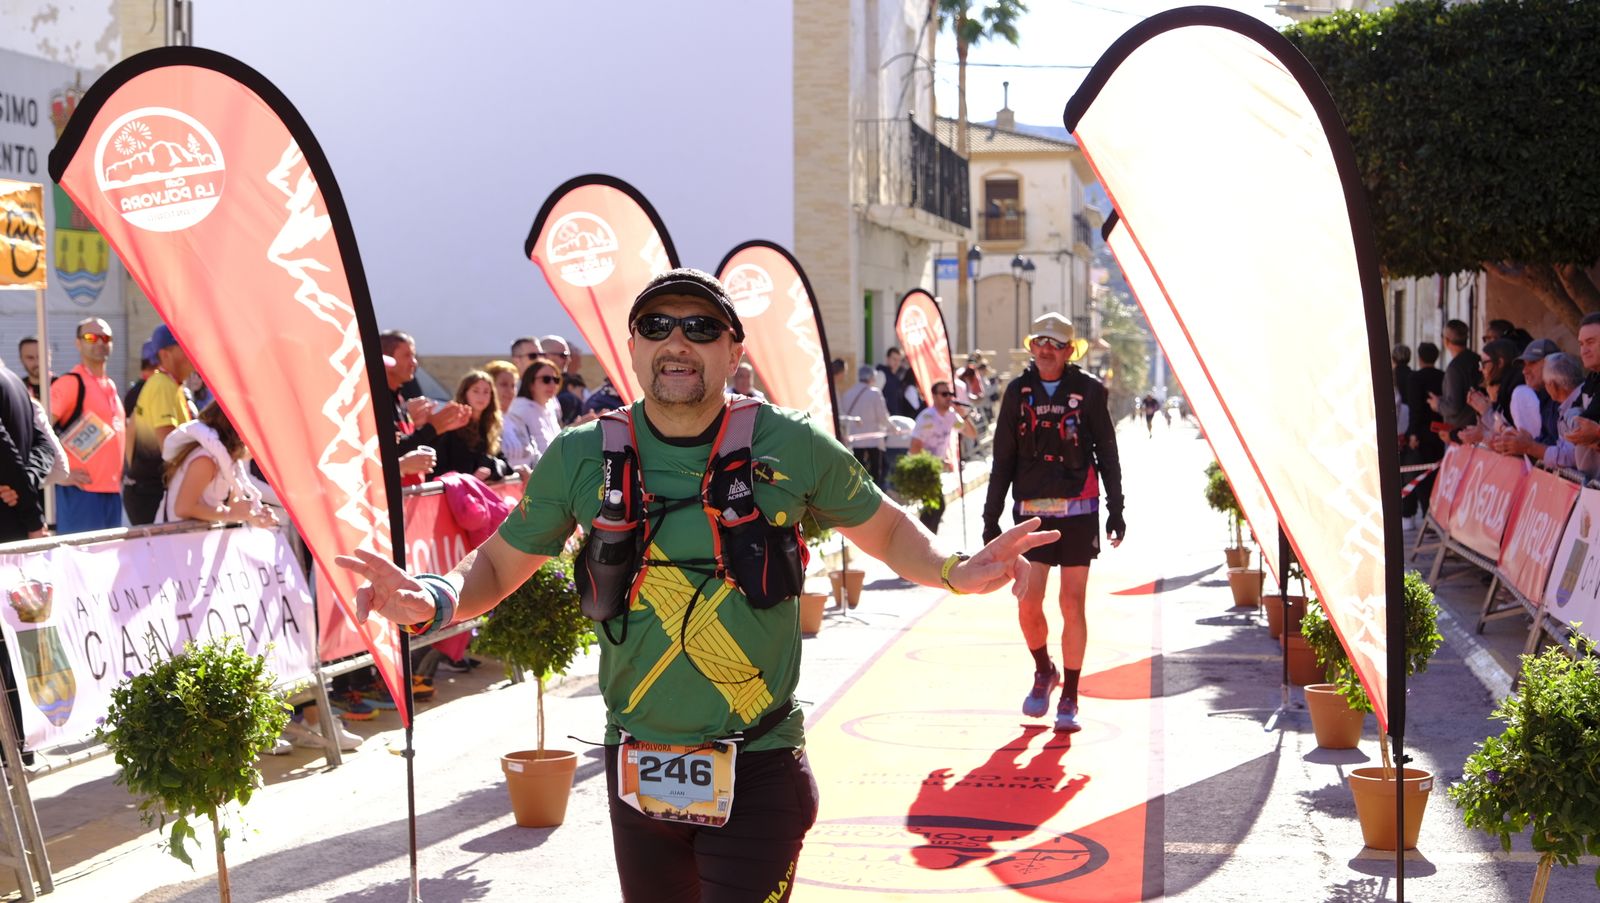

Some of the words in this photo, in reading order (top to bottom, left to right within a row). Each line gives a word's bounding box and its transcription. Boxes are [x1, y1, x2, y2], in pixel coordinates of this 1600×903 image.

[0, 144, 37, 175] NTO
[76, 571, 250, 618] AYUNTAMIENTO
[258, 564, 287, 588] DE
[84, 595, 300, 680] CANTORIA
[640, 756, 712, 787] 246
